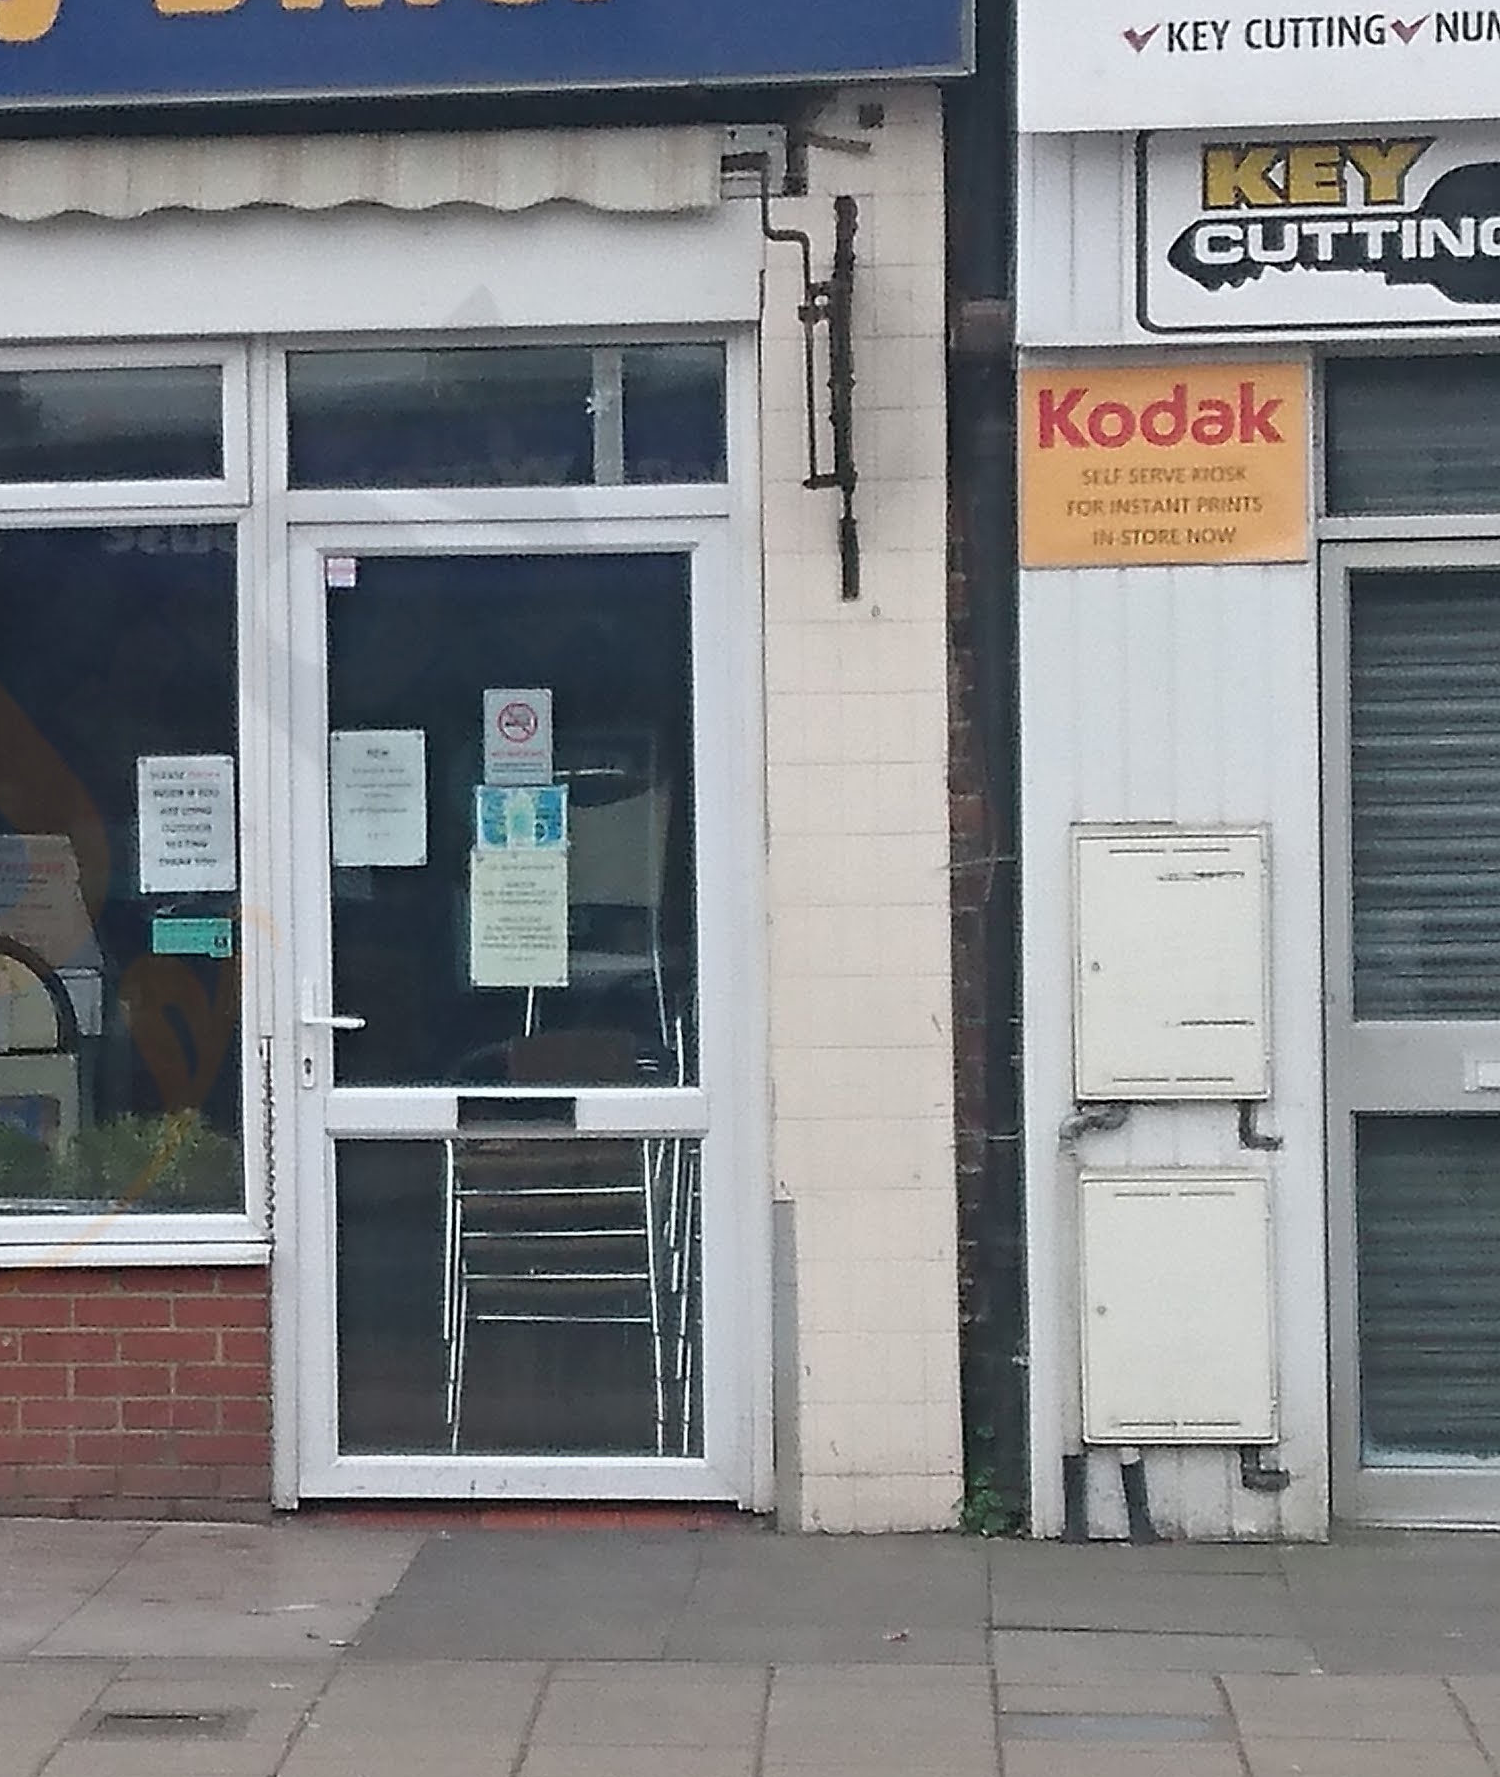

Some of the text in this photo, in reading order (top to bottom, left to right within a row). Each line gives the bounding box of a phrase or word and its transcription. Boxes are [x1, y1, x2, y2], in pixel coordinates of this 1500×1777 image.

[1167, 19, 1231, 53] KEY
[1244, 13, 1386, 50] CUTTING
[1202, 137, 1436, 211] KEY
[1037, 380, 1286, 450] Kodak
[1128, 467, 1187, 485] SERVE
[1191, 465, 1248, 483] KIOSK
[1066, 495, 1264, 517] FOR INSTANT PRINTS
[1186, 525, 1237, 544] NOW
